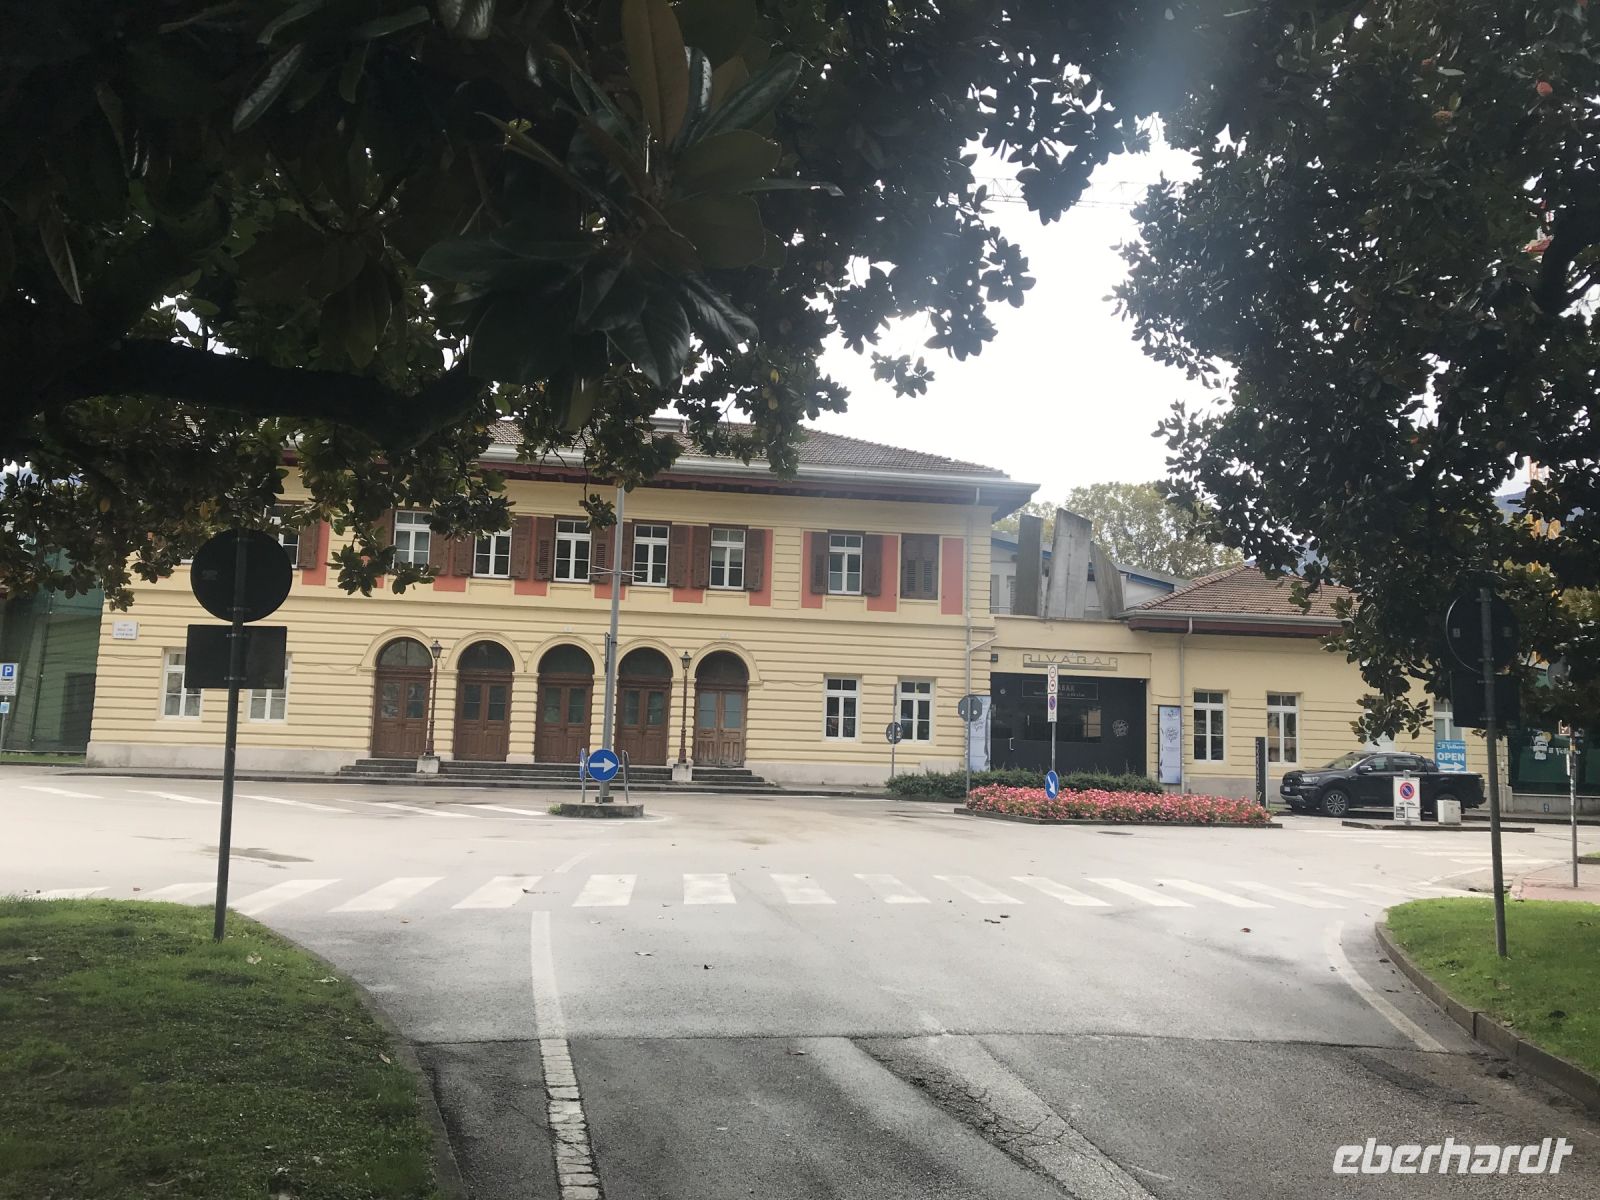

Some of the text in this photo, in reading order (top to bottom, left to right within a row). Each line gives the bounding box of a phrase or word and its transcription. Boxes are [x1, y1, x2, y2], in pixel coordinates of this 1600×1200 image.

[1023, 654, 1118, 668] RIVABAR
[4, 666, 12, 676] P
[1437, 752, 1465, 761] OPEN
